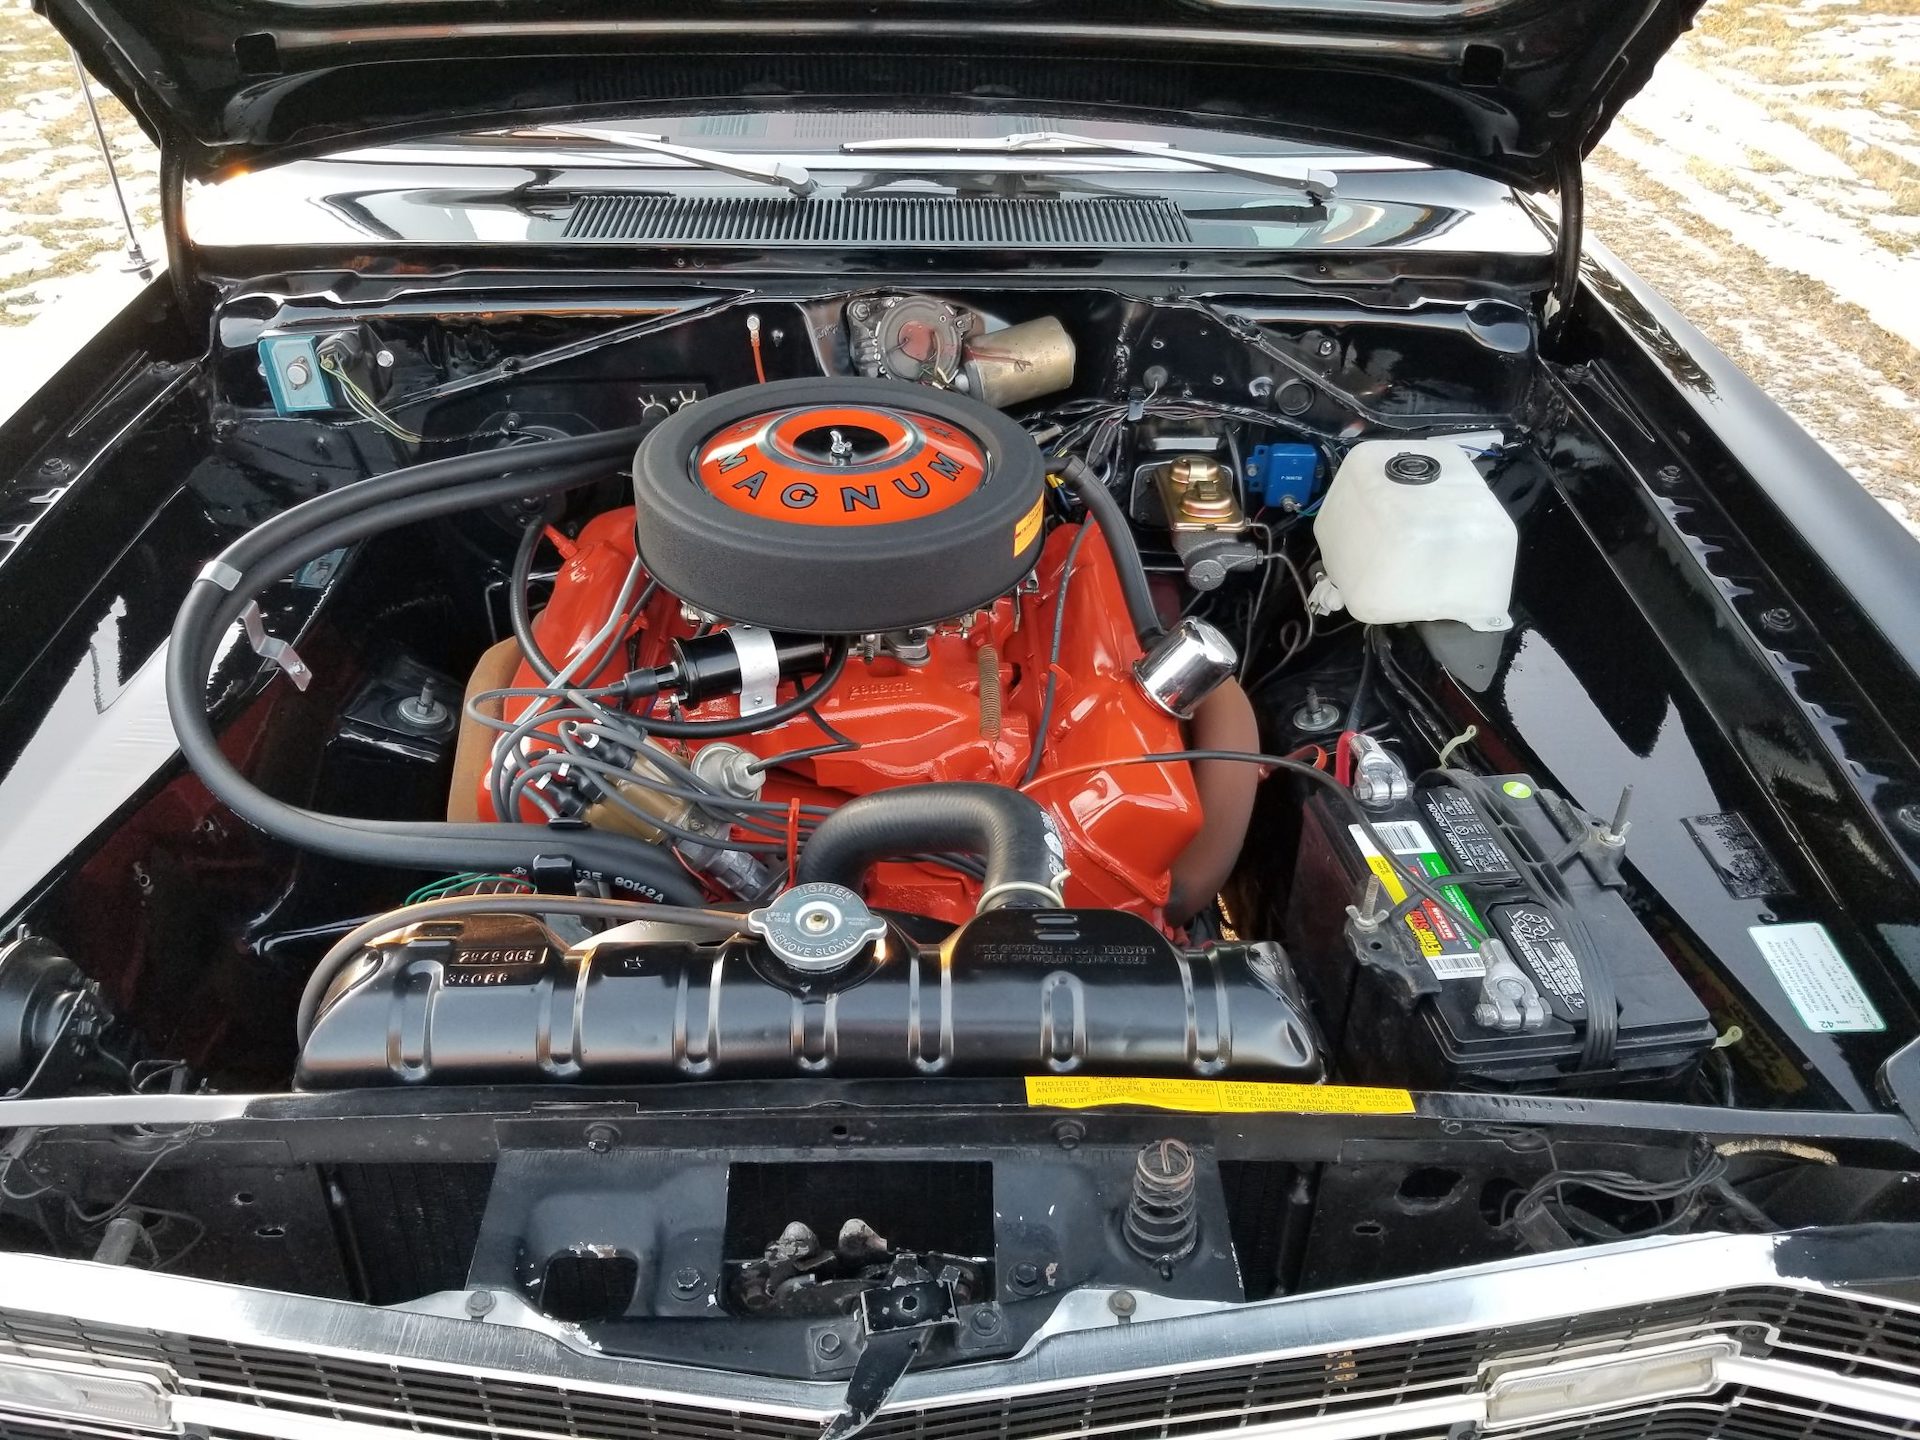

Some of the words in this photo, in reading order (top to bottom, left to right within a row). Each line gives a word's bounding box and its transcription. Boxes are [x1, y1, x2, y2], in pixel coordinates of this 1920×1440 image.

[717, 447, 965, 512] MAGNUM
[1426, 803, 1448, 827] POISON
[1445, 832, 1469, 860] DANGER
[795, 883, 853, 901] TIGHTEN
[770, 928, 812, 956] REMOVE
[815, 934, 857, 956] SLOWLY
[1820, 1020, 1834, 1029] 42
[1091, 1092, 1125, 1102] DEALER
[1268, 1103, 1356, 1112] RECOMMENDATIONS
